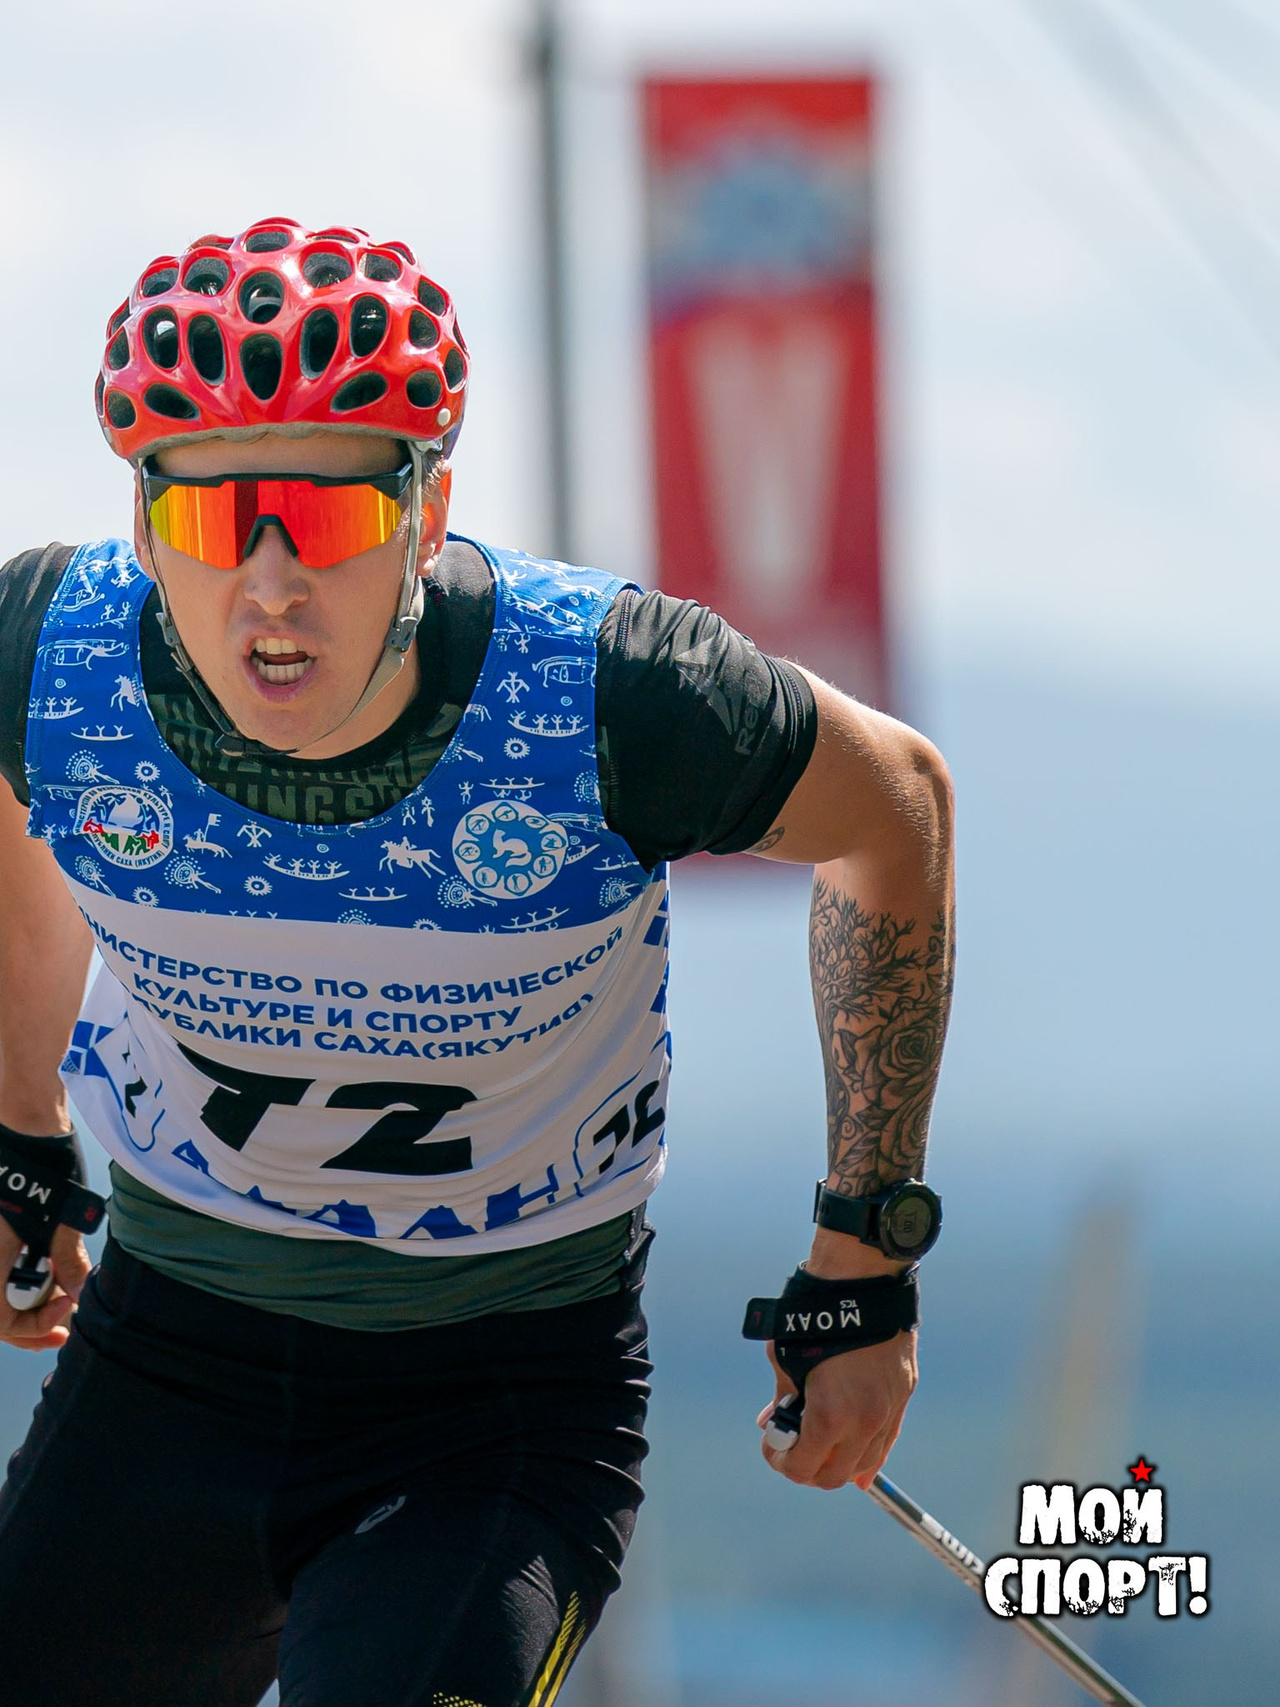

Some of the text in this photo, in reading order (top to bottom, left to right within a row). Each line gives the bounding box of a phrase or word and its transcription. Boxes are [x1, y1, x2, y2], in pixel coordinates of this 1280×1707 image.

[92, 832, 117, 861] ПУБЛИКИ
[78, 906, 624, 1006] НИСТЕРСТВО ПО ФИЗИЧЕСКОЙ
[131, 992, 303, 1049] ПУБЛИКИ
[132, 971, 523, 1035] КУЛЬТУРЕ И СПОРТУ
[785, 1308, 862, 1333] MOAX
[839, 1299, 859, 1309] TCS
